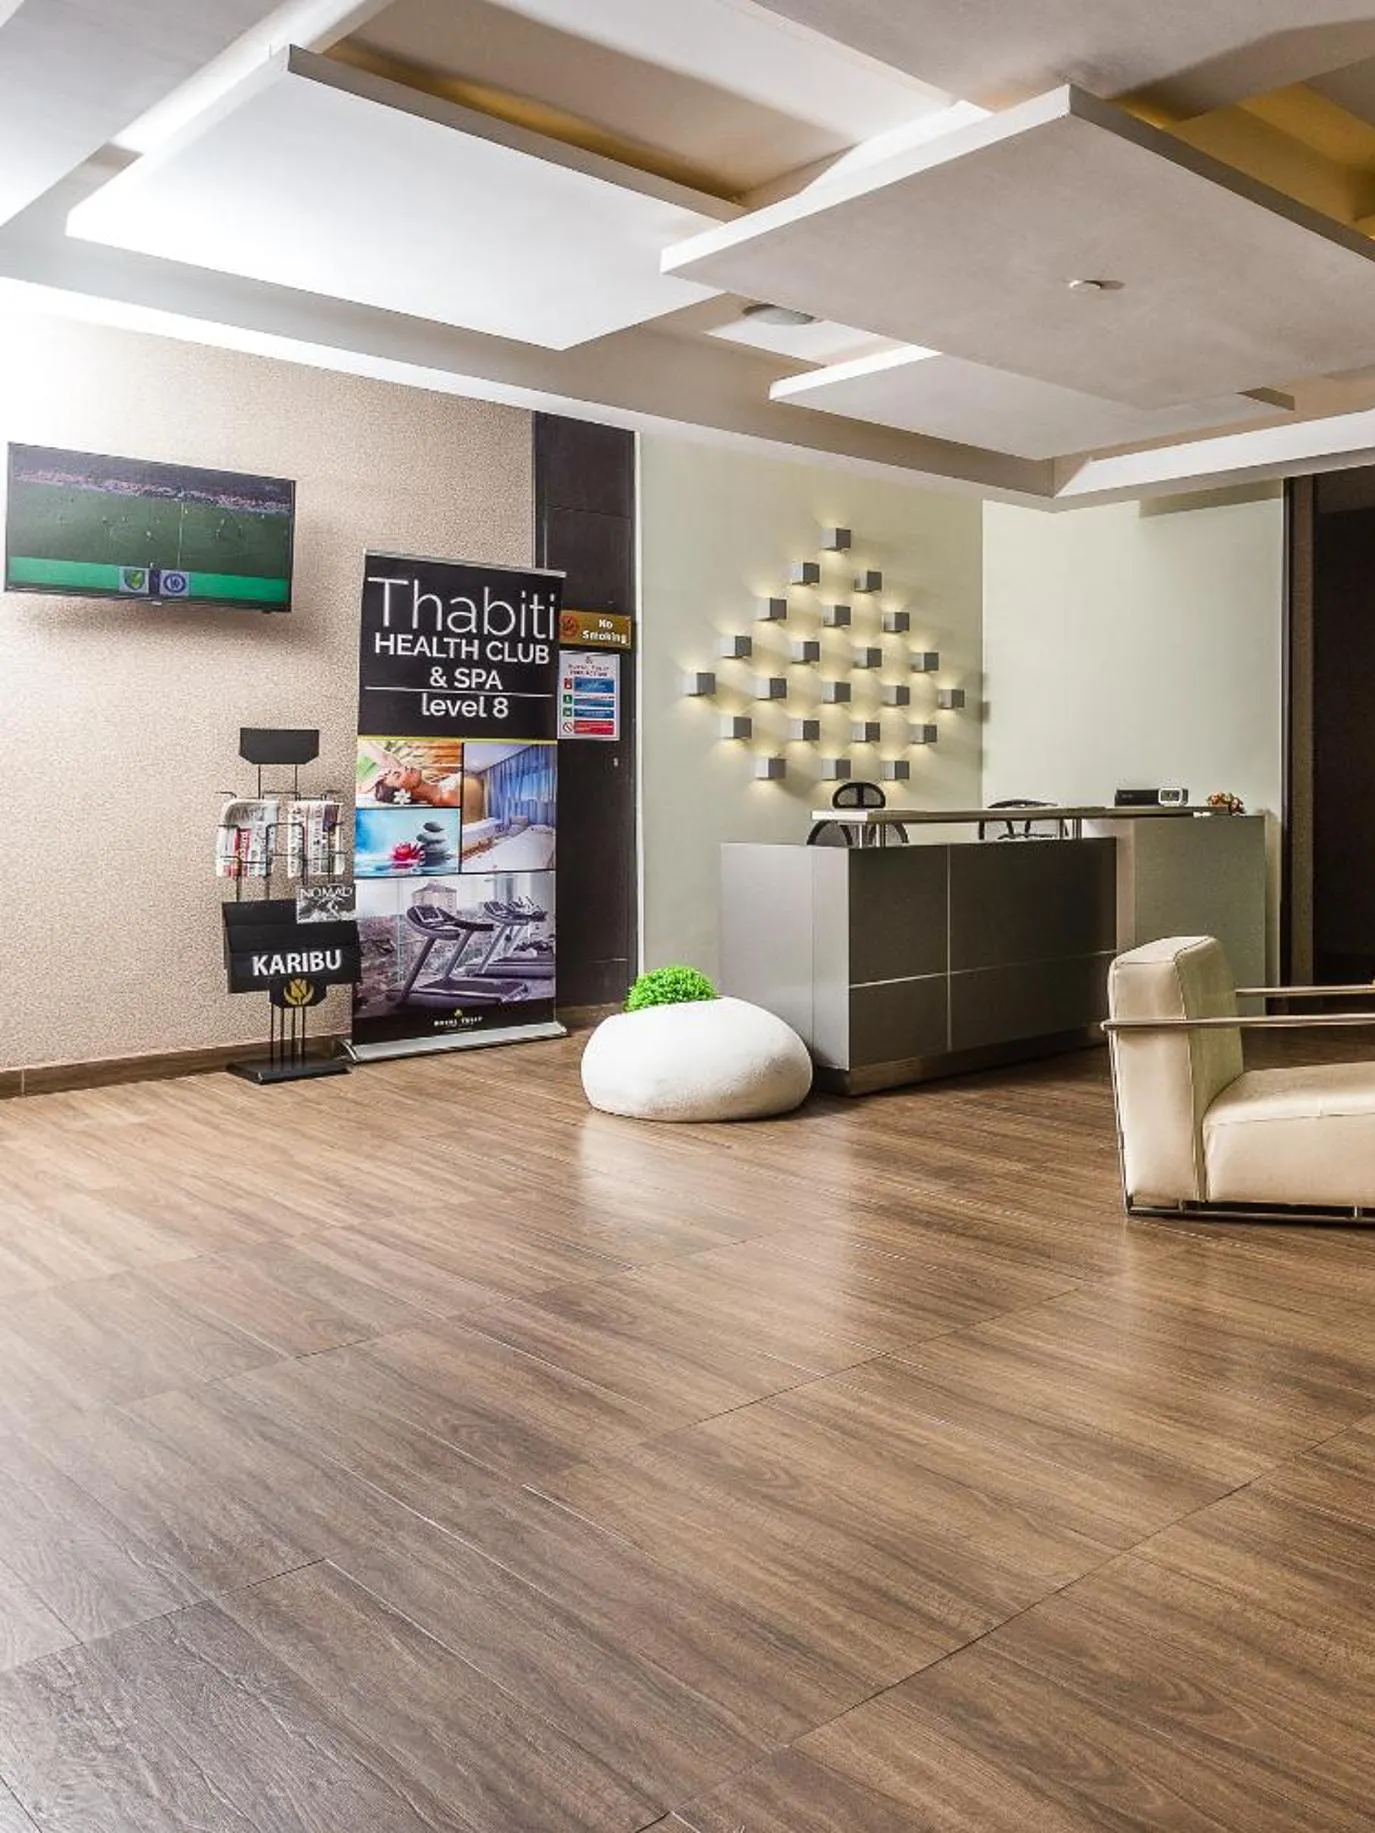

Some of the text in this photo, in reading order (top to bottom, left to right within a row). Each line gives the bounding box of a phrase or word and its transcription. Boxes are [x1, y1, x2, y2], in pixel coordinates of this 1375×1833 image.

[368, 577, 555, 640] Thabiti
[598, 619, 614, 629] No
[375, 632, 549, 664] HEALTH CLUB
[582, 630, 627, 644] Smoking
[429, 666, 503, 690] & SPA
[421, 693, 509, 719] level 8
[300, 887, 353, 900] NOMAD
[252, 949, 342, 976] KARIBU
